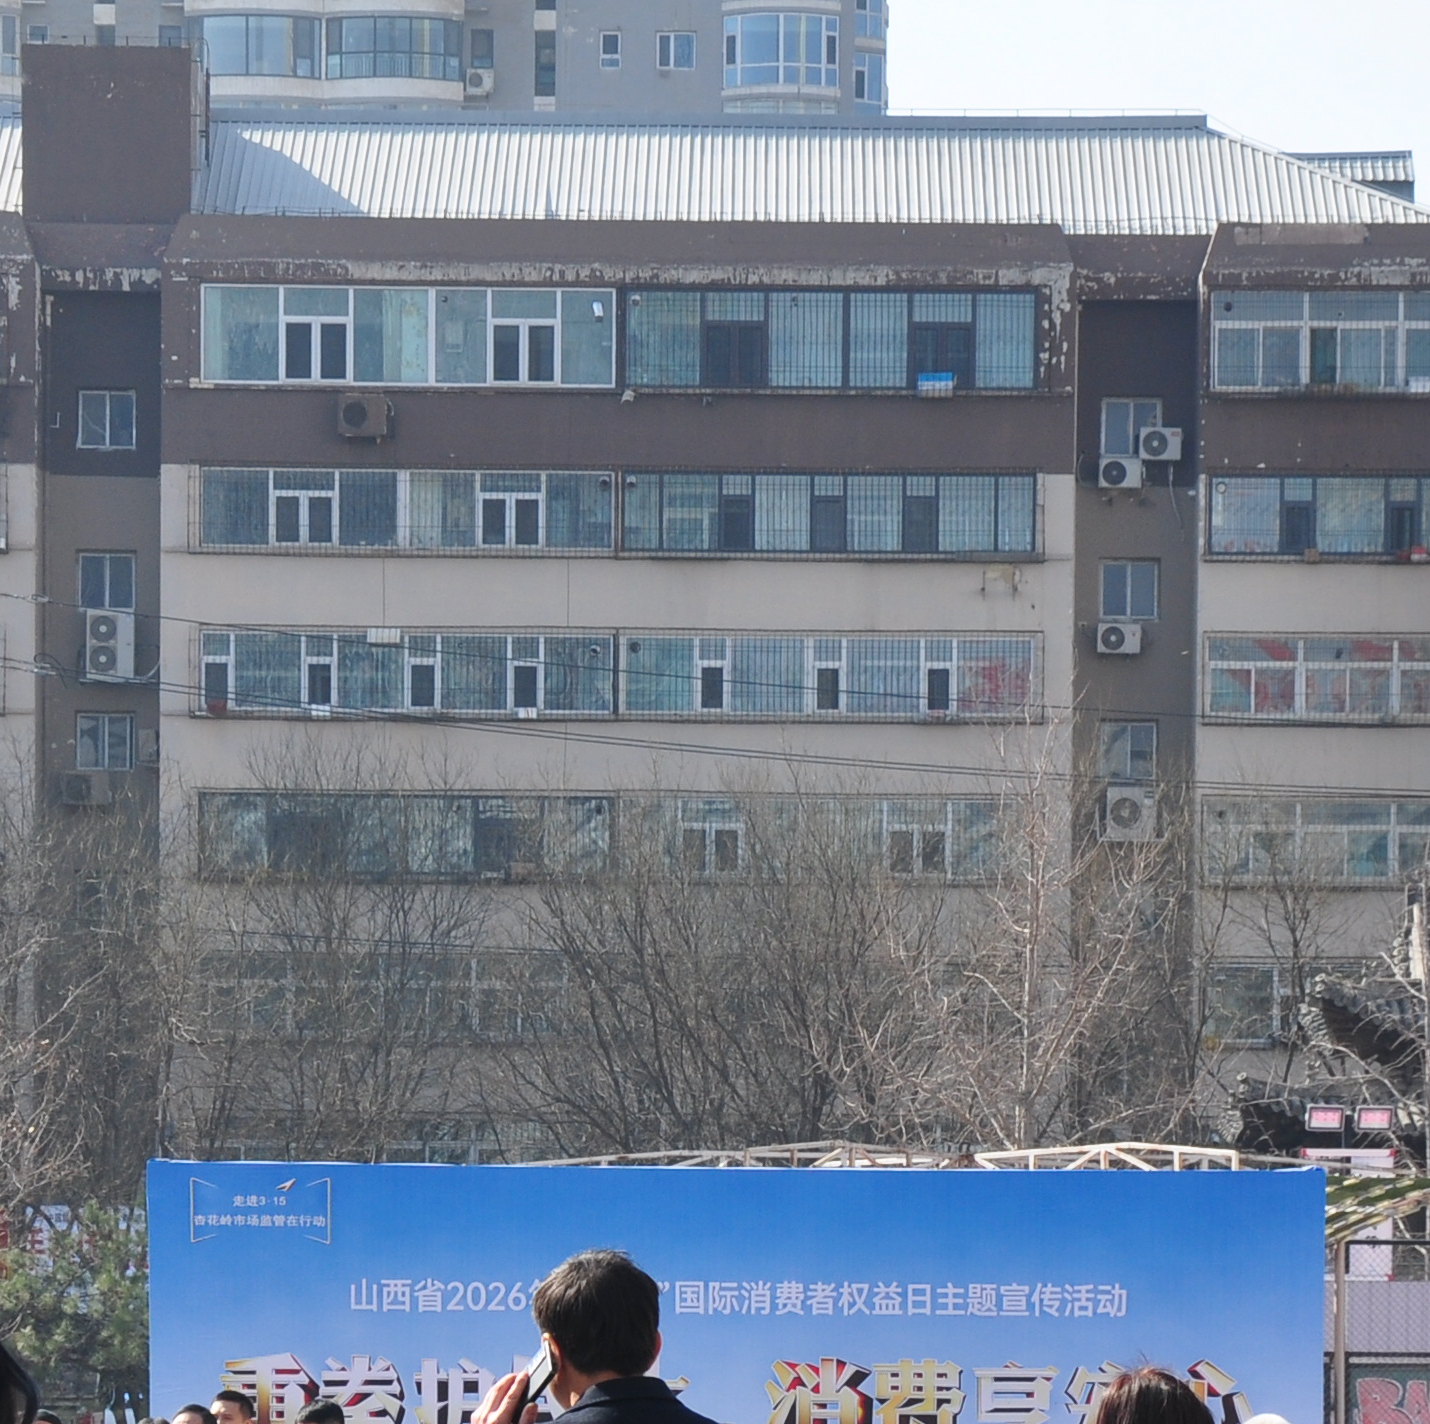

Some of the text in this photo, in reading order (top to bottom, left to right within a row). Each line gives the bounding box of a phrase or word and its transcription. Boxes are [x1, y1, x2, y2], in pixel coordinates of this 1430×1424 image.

[193, 1214, 326, 1227] 杏花岭市场监管在行动
